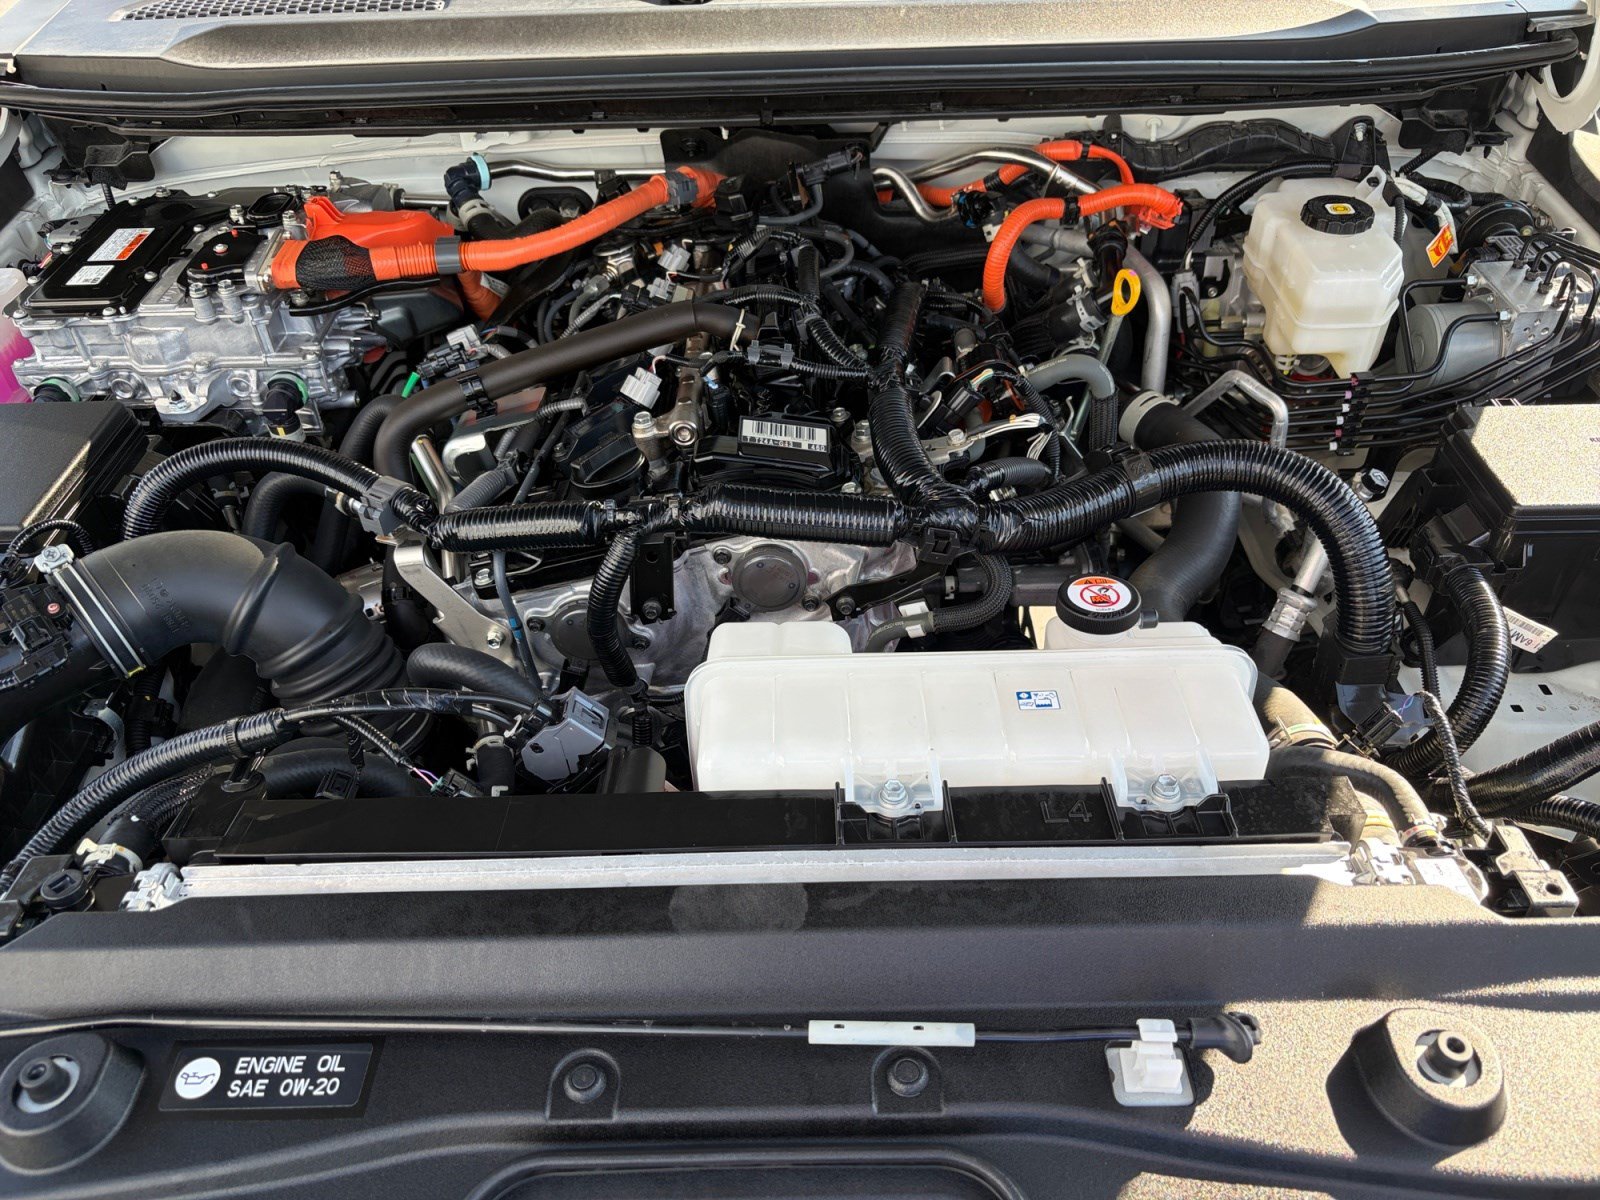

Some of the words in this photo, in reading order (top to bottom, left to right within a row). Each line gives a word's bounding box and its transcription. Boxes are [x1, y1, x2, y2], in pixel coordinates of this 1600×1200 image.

[1040, 800, 1092, 823] L4
[235, 1056, 306, 1075] ENGINE
[317, 1055, 346, 1073] OIL
[227, 1079, 269, 1098] SAE
[279, 1078, 340, 1097] 0W-20
